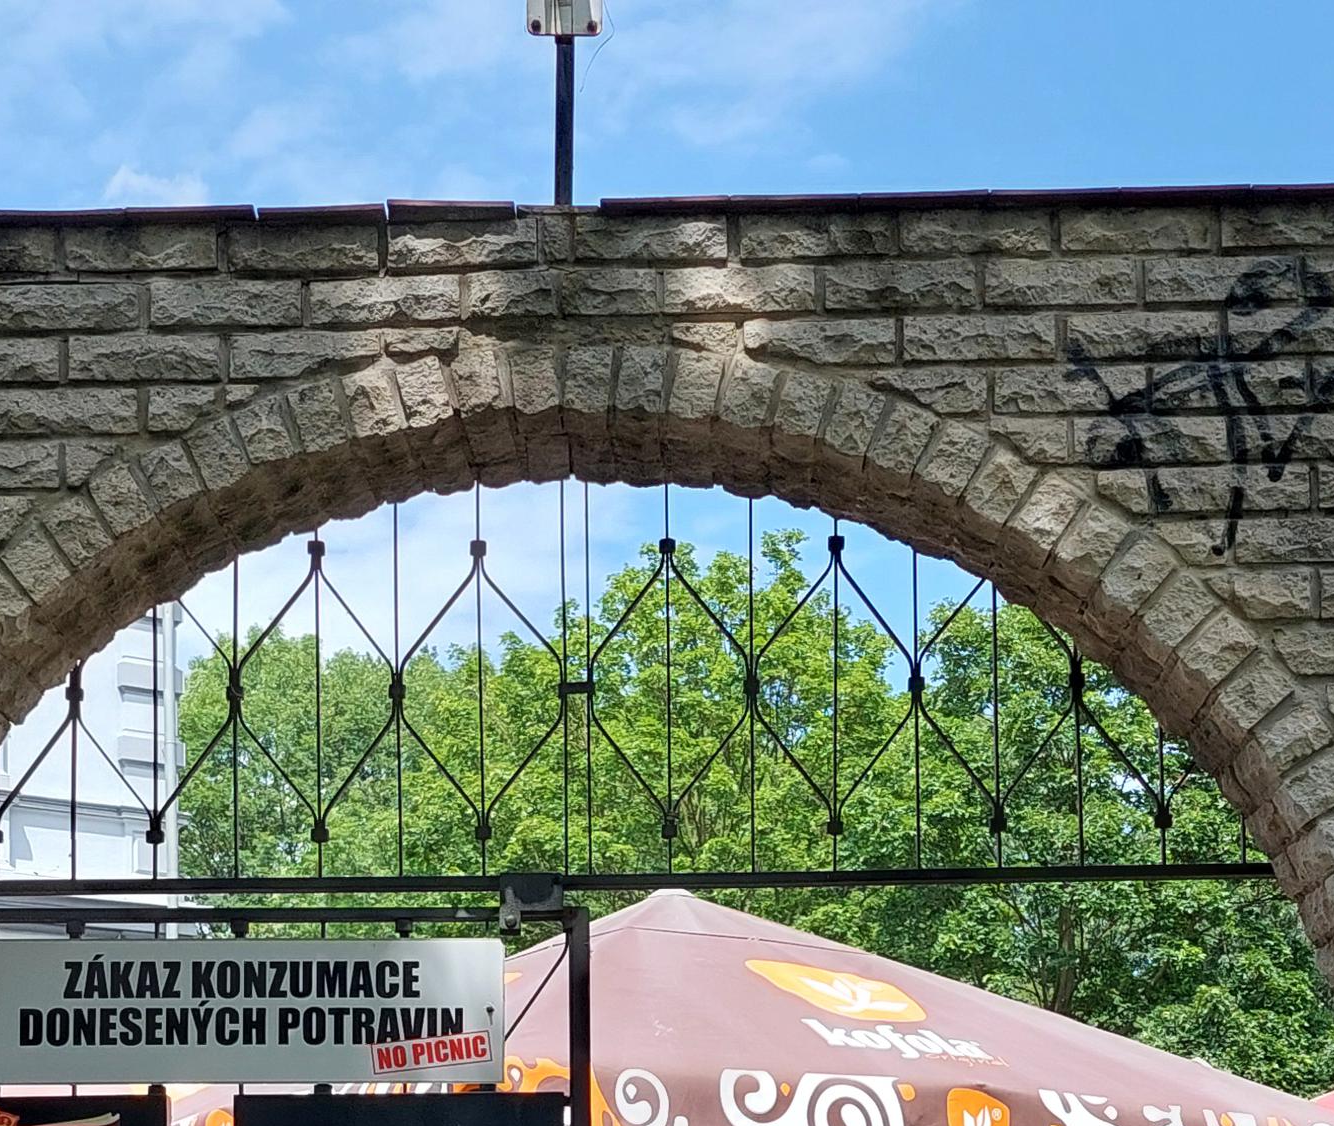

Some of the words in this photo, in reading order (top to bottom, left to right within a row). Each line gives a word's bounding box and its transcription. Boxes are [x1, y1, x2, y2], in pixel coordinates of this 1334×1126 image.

[63, 954, 181, 999] ZÁKAZ
[192, 961, 420, 999] KONZUMACE
[19, 1000, 267, 1046] DONESENÝCH
[278, 1007, 464, 1046] POTRAVIN
[800, 1018, 994, 1060] kofola
[376, 1043, 407, 1069] NO
[412, 1035, 487, 1066] PICNIC
